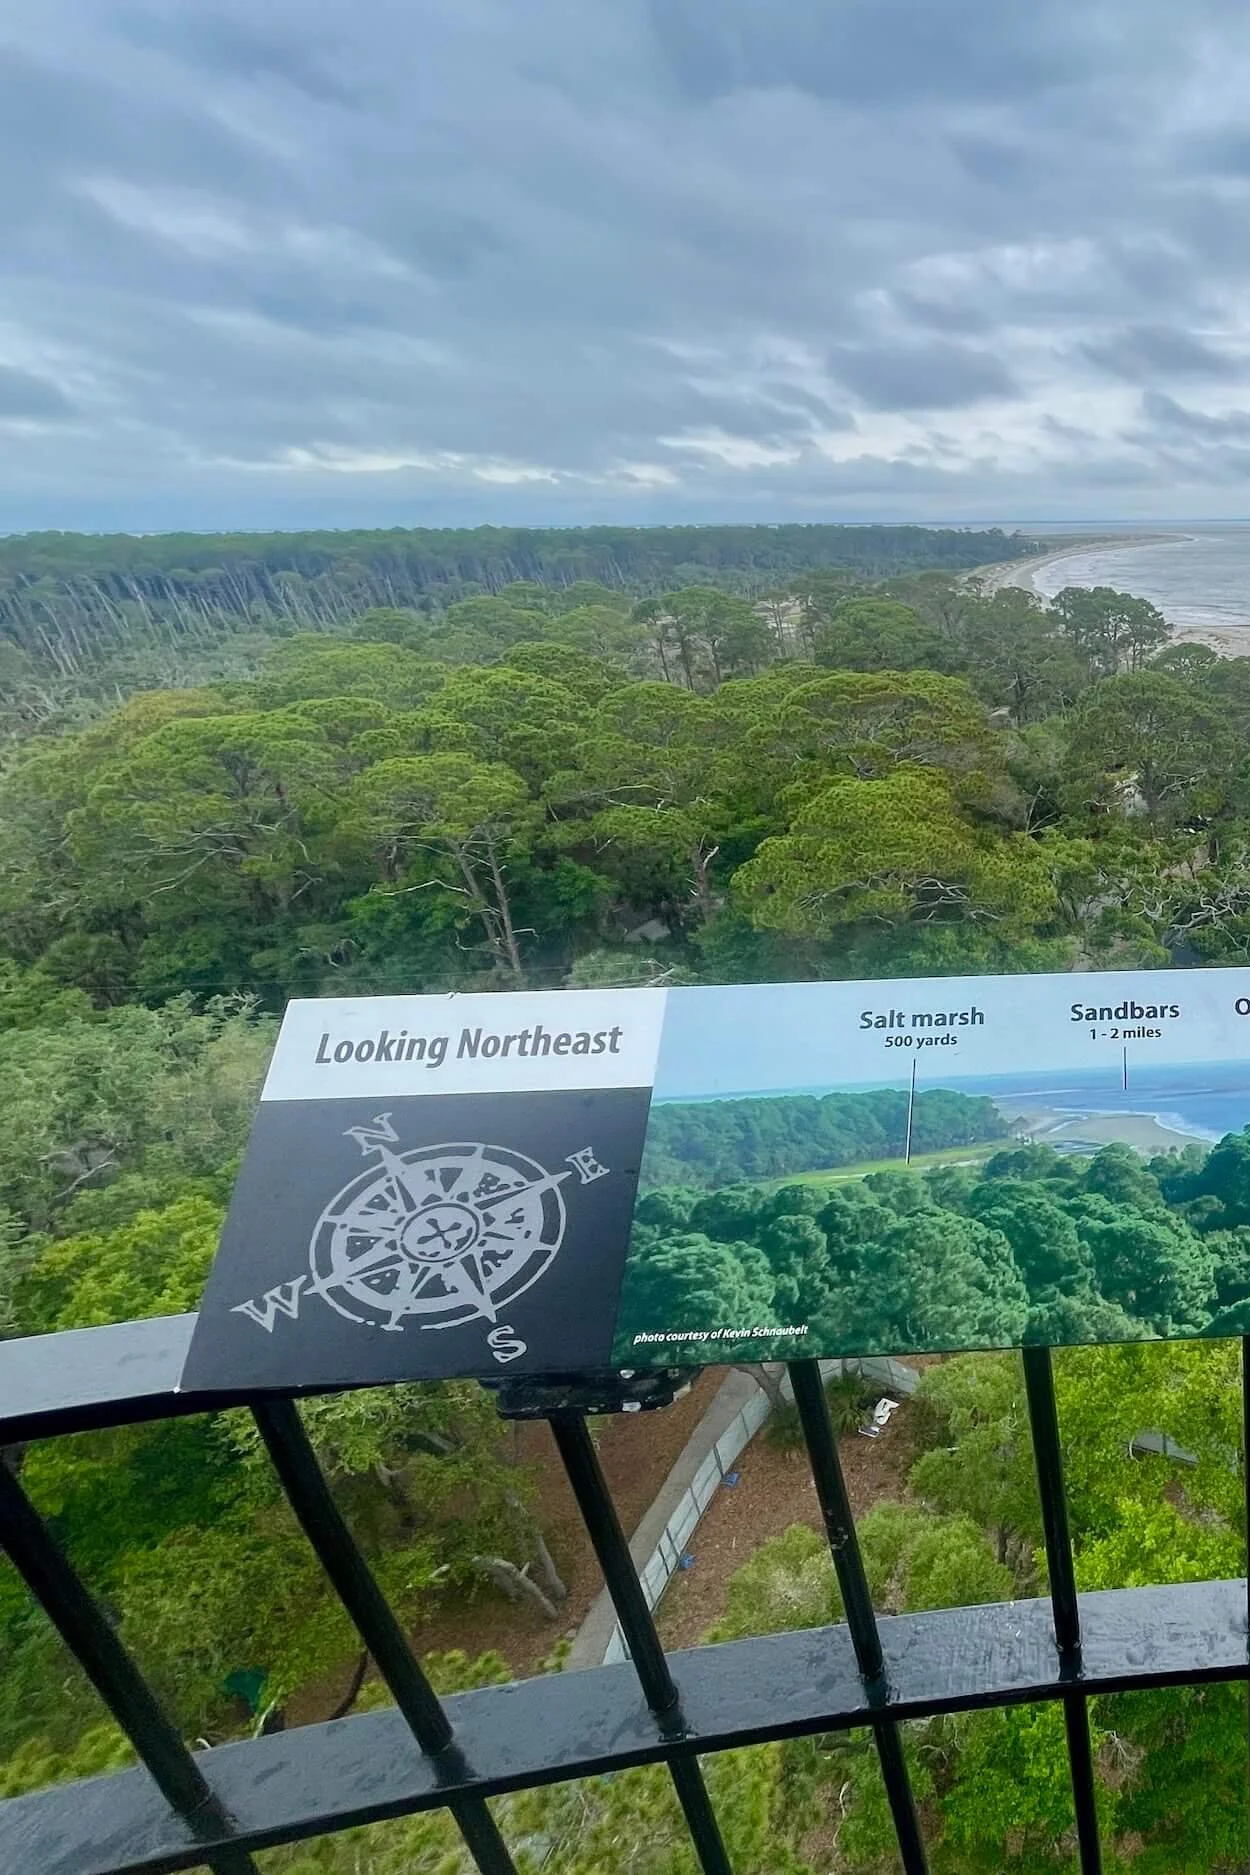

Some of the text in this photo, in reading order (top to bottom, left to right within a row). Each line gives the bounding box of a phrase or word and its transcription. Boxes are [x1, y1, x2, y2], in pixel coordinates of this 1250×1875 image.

[859, 1007, 985, 1030] Salt marsh
[1070, 1000, 1180, 1022] Sandbars
[315, 1025, 623, 1068] Looking Northeast
[884, 1032, 958, 1050] 500 yards
[1089, 1027, 1097, 1040] 1
[1110, 1027, 1119, 1040] 2
[1122, 1025, 1162, 1039] miles
[342, 1112, 400, 1156] N
[564, 1146, 611, 1185] E
[230, 1274, 307, 1332] W
[487, 1325, 527, 1363] S
[633, 1325, 809, 1345] photo courtesy of Kevin Schnaubelt
